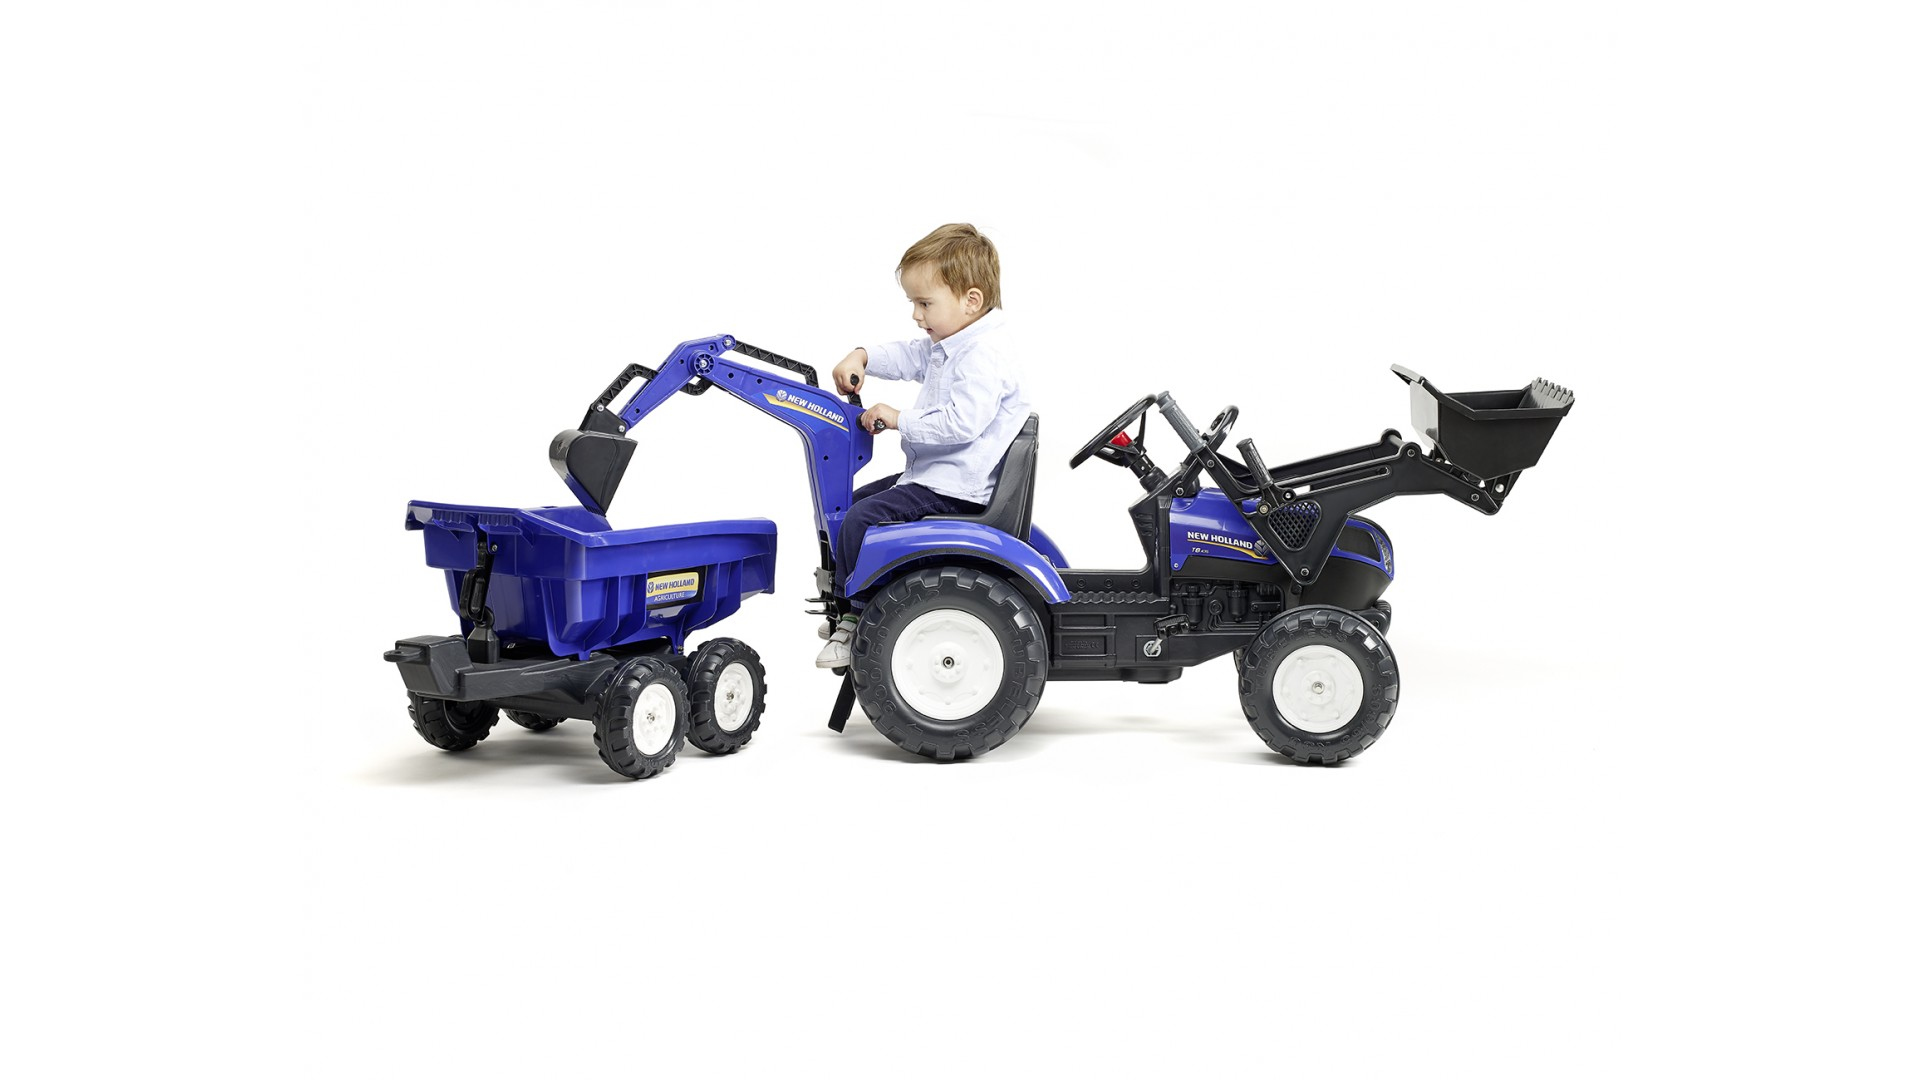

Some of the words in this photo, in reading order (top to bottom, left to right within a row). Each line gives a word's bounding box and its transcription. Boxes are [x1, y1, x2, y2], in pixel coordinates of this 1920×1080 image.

[788, 394, 808, 407] NEW
[807, 402, 845, 424] HOLLAND
[1187, 531, 1209, 541] NEW
[1211, 534, 1253, 549] HOLLAND
[655, 581, 669, 591] NEW
[668, 578, 695, 589] HOLLAND
[654, 592, 685, 602] AGRICULTURE
